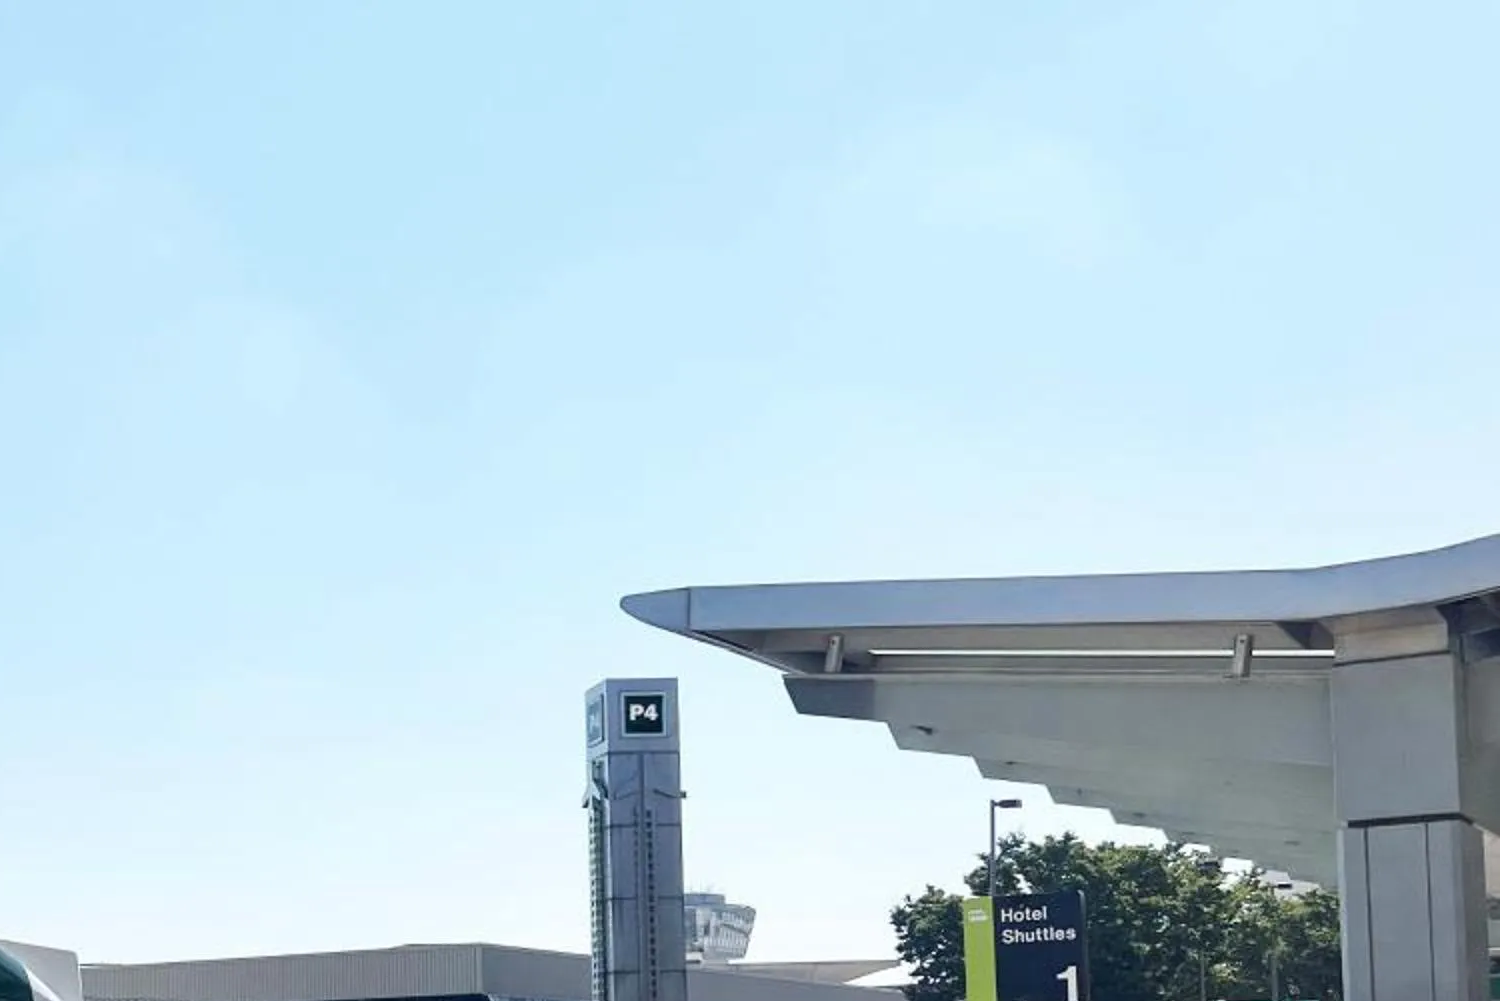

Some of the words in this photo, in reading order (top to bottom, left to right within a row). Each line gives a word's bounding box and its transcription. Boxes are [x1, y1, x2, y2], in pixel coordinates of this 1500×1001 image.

[629, 703, 659, 721] P4
[1001, 905, 1048, 923] Hotel
[1002, 927, 1077, 944] Shuttles
